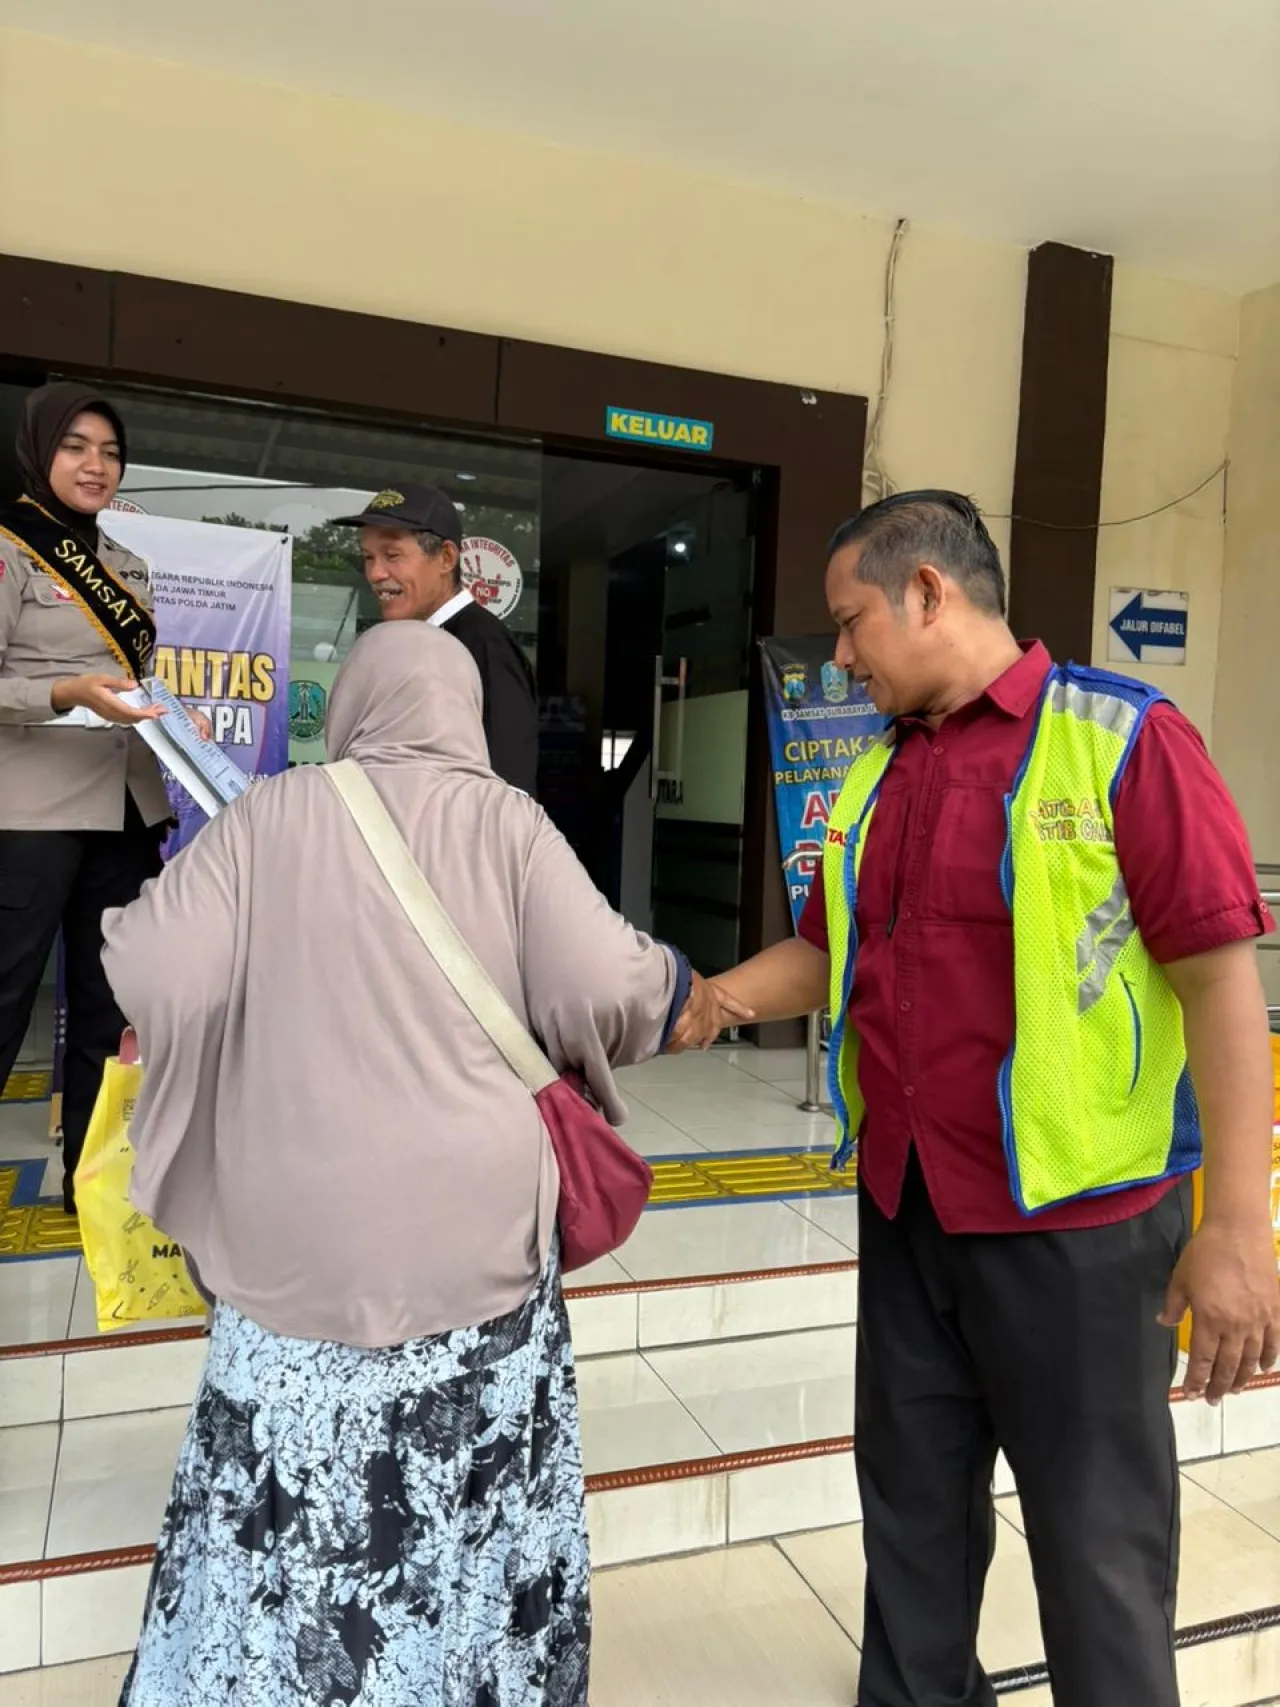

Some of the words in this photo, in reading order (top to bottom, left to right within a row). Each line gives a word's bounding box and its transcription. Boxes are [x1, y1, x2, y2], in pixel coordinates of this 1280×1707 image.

[611, 412, 708, 445] KELUAR
[55, 539, 140, 627] SAMSAT
[151, 571, 180, 581] EGARA
[181, 574, 224, 587] REPUBLIK
[226, 579, 274, 592] INDONESIA
[170, 586, 195, 596] JAWA
[198, 588, 226, 598] TIMUR
[178, 598, 208, 609] POLDA
[210, 600, 236, 611] JATIM
[1120, 619, 1149, 632] JALUR
[1150, 621, 1185, 635] DIFABEL
[155, 645, 277, 703] ANTAS
[784, 735, 876, 762] CIPTAK
[152, 1243, 182, 1259] MA
